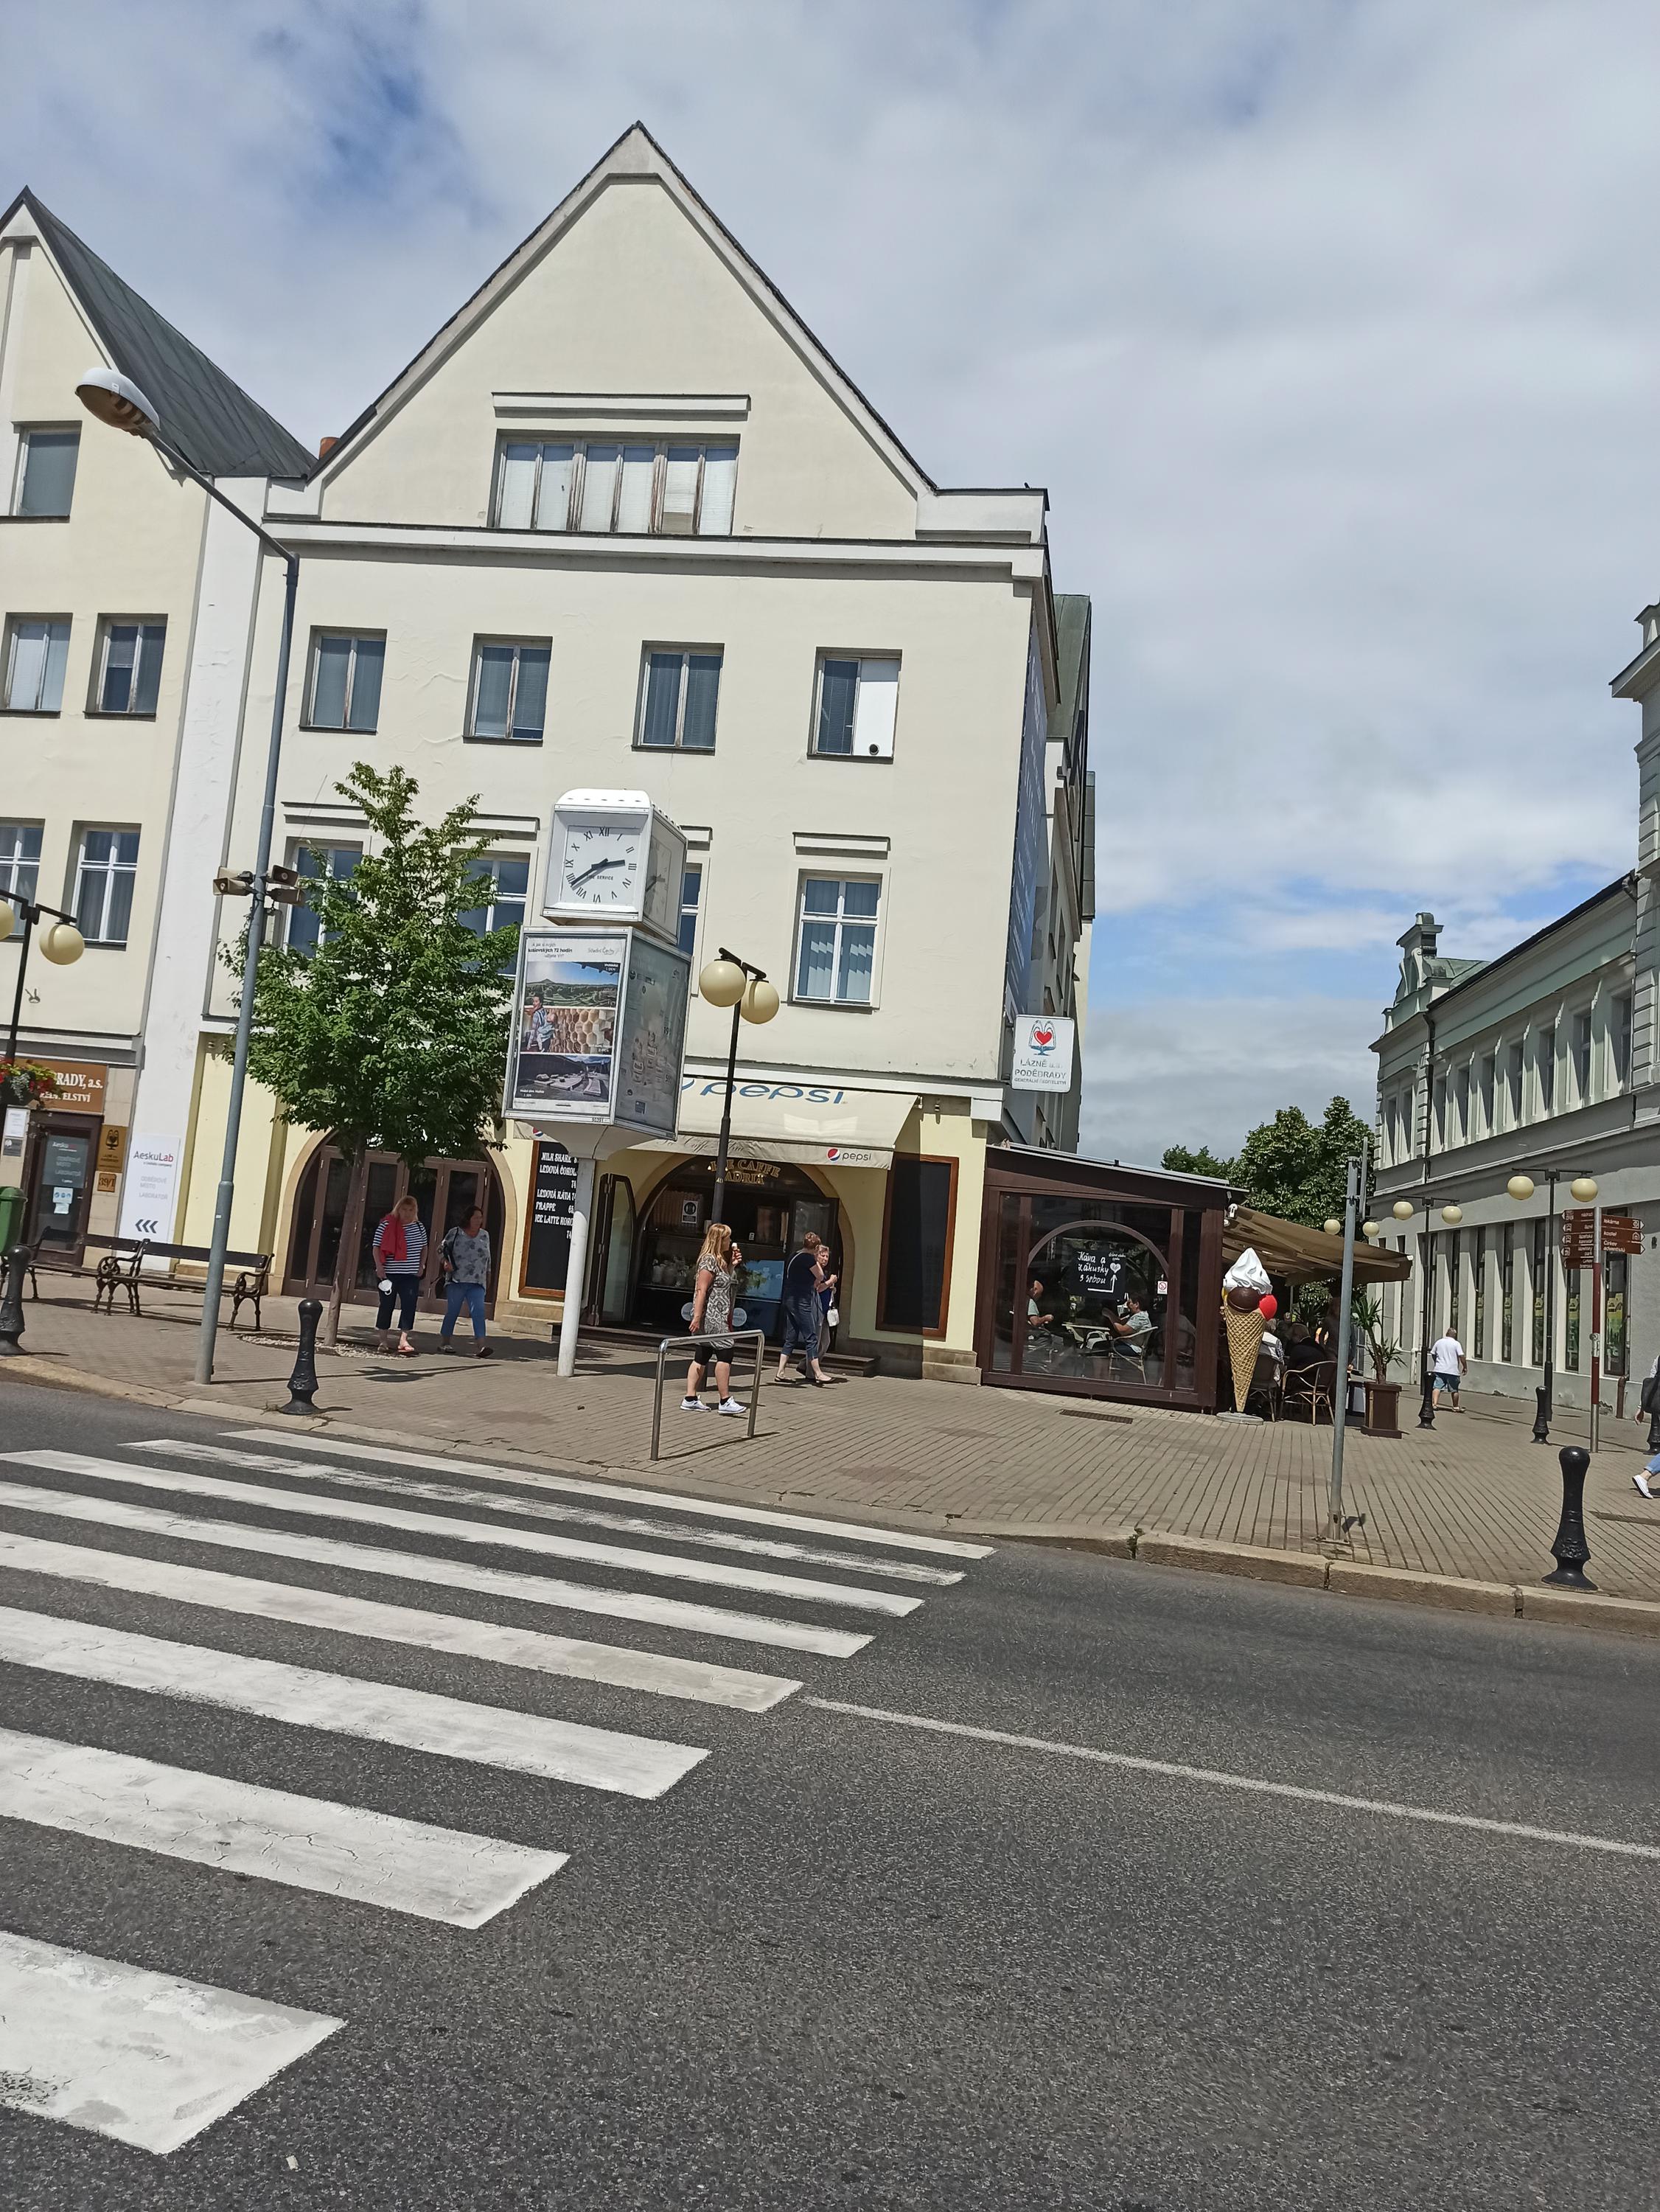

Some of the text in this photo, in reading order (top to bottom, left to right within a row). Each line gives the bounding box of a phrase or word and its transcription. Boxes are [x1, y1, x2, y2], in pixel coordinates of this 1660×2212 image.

[599, 827, 610, 837] XII
[1020, 1058, 1047, 1067] LÁZNĚ
[1015, 1069, 1066, 1079] PODĚBRADY
[56, 1073, 103, 1089] RADY, a.s.
[700, 1082, 844, 1104] pepsi
[133, 1151, 174, 1162] AeskuLab
[541, 1152, 554, 1162] MILK
[842, 1152, 871, 1161] pepsi
[539, 1165, 577, 1176] LEDOVÁ ČOKOL
[711, 1159, 781, 1178] IE CAFFE
[725, 1171, 764, 1185] ADRIA
[537, 1189, 557, 1199] LEDOVÁ
[535, 1201, 556, 1212] FRAPPE
[534, 1214, 573, 1227] ICE LATTE KOKO
[1078, 1251, 1096, 1262] Káva
